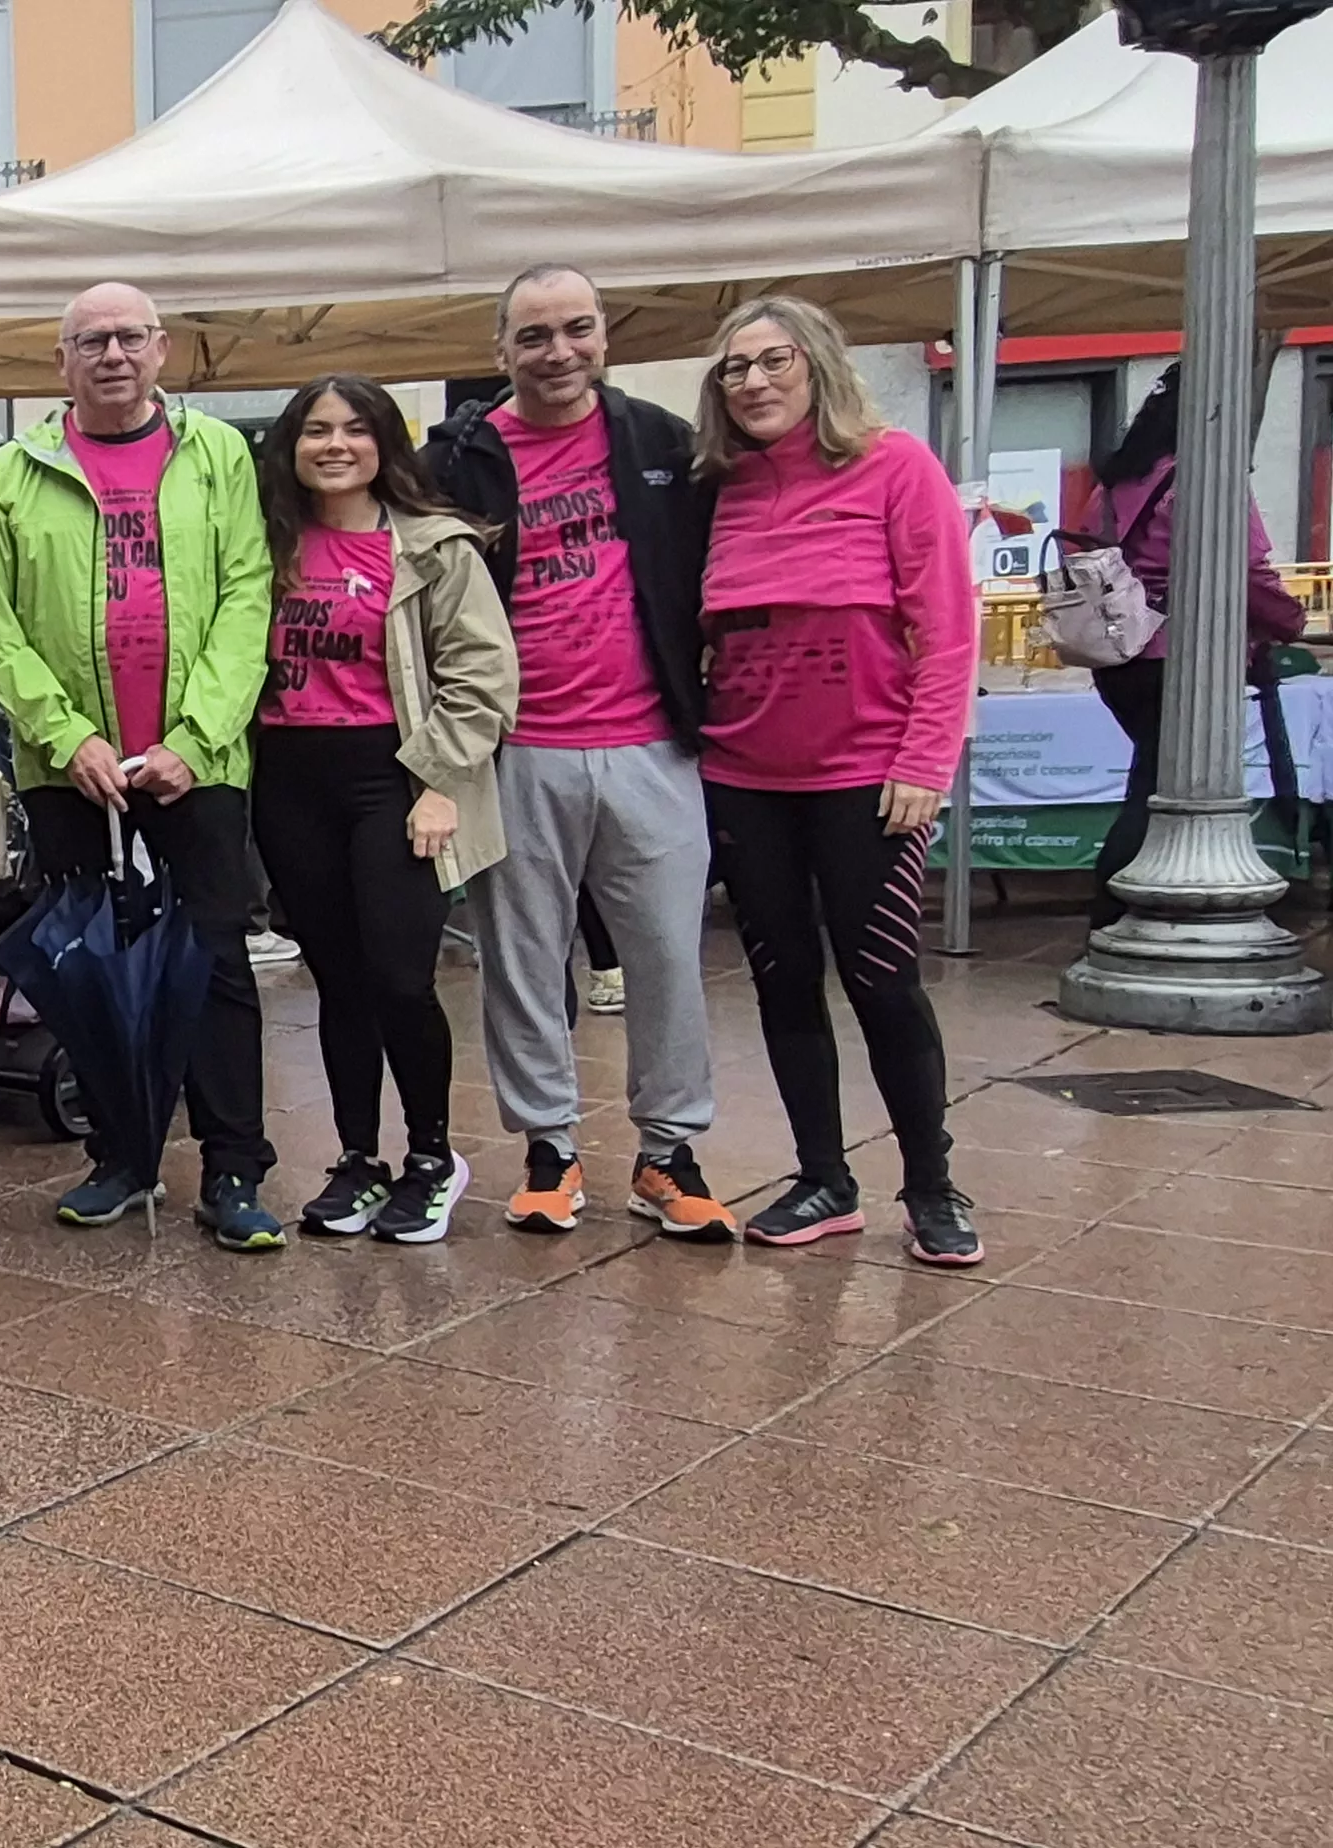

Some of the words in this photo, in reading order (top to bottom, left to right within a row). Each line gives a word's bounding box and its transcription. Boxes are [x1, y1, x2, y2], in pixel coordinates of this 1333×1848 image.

[519, 487, 604, 530] UNIDOS
[104, 510, 146, 539] DOS
[560, 518, 590, 549] EN
[283, 627, 309, 658] EN
[312, 629, 364, 662] CADA
[971, 816, 1027, 830] pañola
